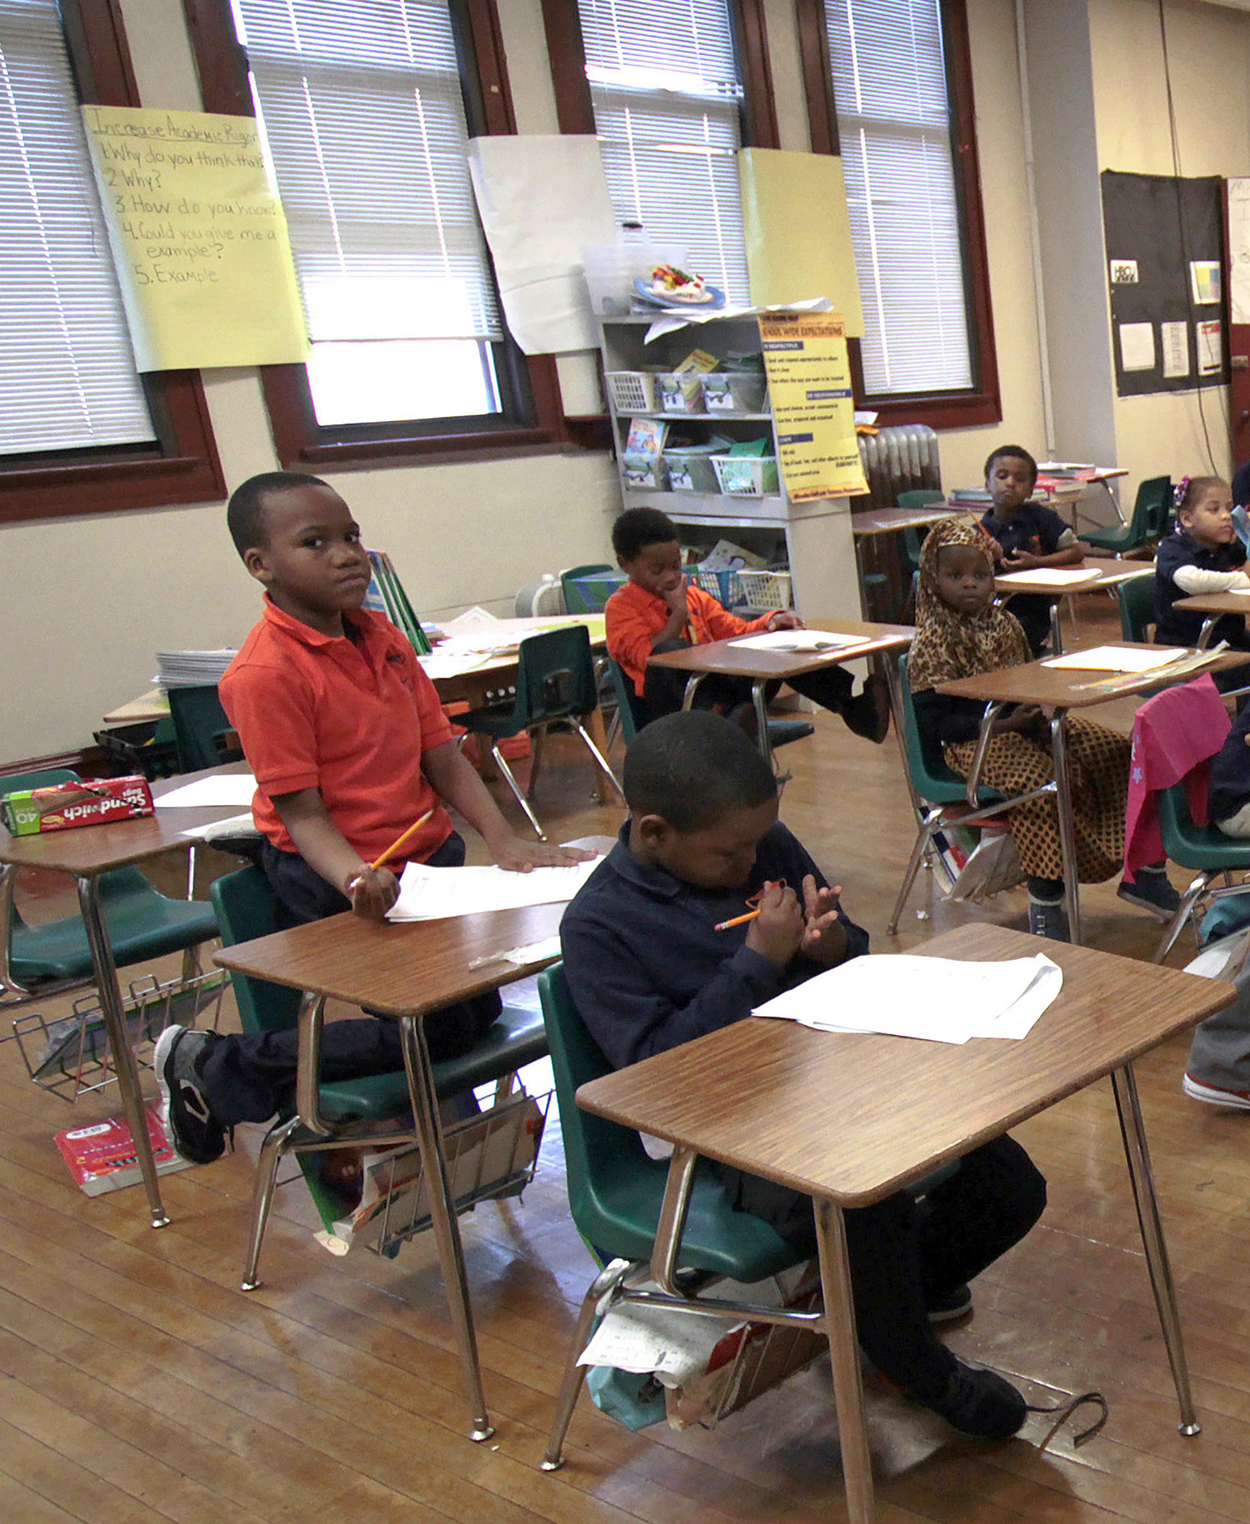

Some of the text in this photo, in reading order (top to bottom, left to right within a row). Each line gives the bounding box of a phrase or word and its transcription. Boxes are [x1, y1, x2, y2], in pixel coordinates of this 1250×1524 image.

[93, 108, 166, 137] Increase
[145, 147, 165, 164] do
[168, 155, 194, 169] you
[197, 151, 234, 168] think
[132, 194, 170, 214] How
[178, 198, 200, 214] do
[208, 202, 235, 219] you
[178, 228, 203, 245] you
[205, 227, 235, 245] give
[240, 229, 262, 241] me
[266, 231, 277, 241] a
[15, 812, 38, 824] 40
